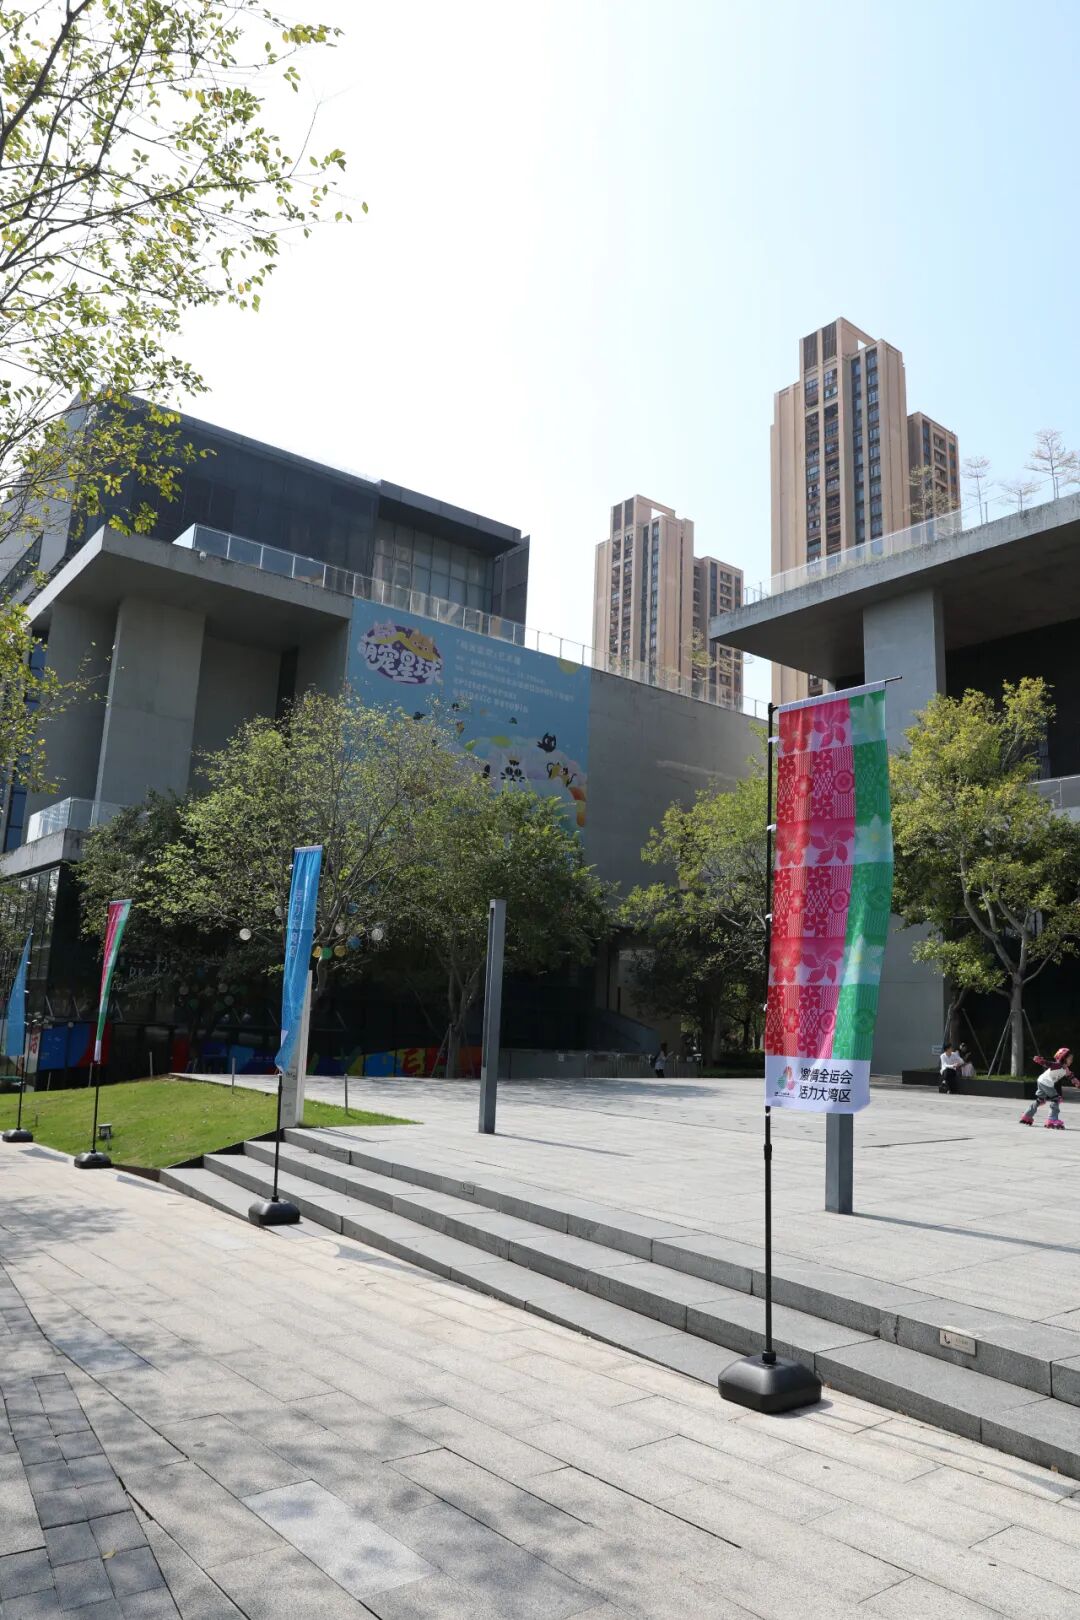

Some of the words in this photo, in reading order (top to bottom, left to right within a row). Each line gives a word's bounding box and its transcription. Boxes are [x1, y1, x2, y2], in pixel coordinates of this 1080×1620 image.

[799, 1067, 854, 1085] 激情全运会
[798, 1085, 852, 1103] 活力大湾区
